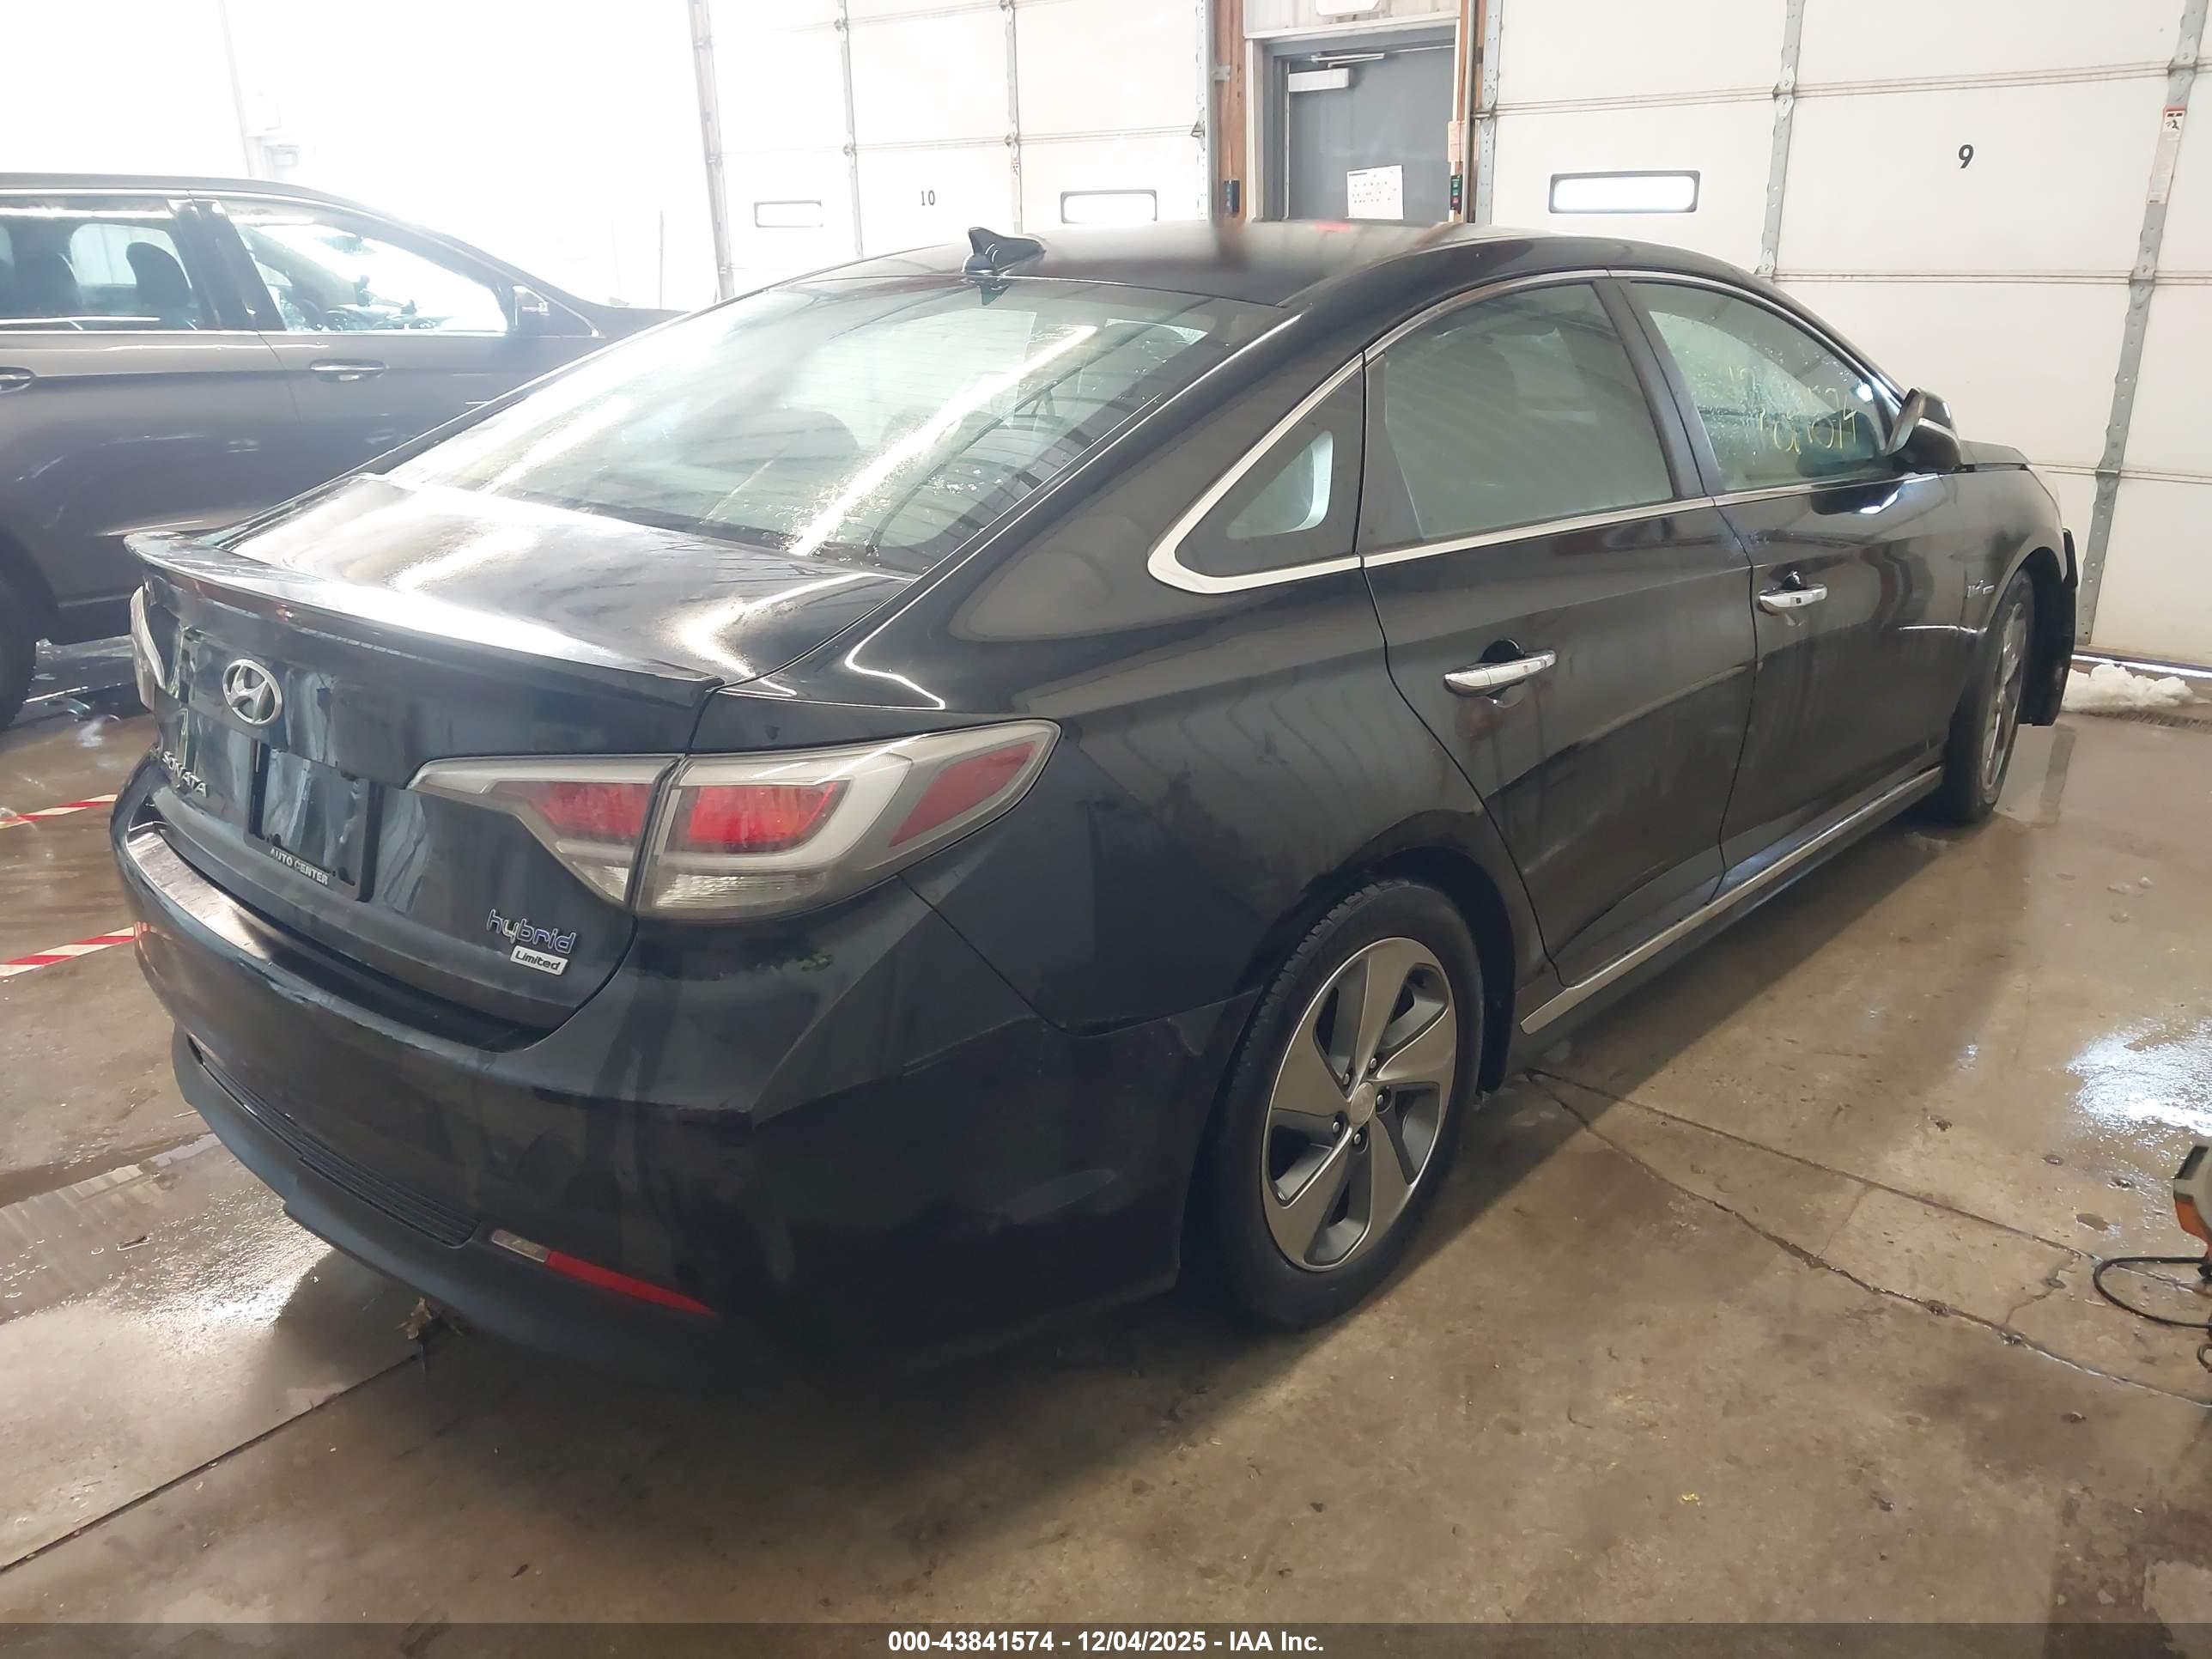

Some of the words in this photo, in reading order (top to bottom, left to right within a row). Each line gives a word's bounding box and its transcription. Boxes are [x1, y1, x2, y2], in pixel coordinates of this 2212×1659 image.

[1958, 144, 1974, 169] 9
[921, 190, 935, 206] 10
[162, 751, 207, 798] SONATA
[270, 848, 294, 866] AUTO
[294, 860, 329, 885] CENTER
[486, 908, 576, 954] hybrid
[515, 950, 561, 970] Limited
